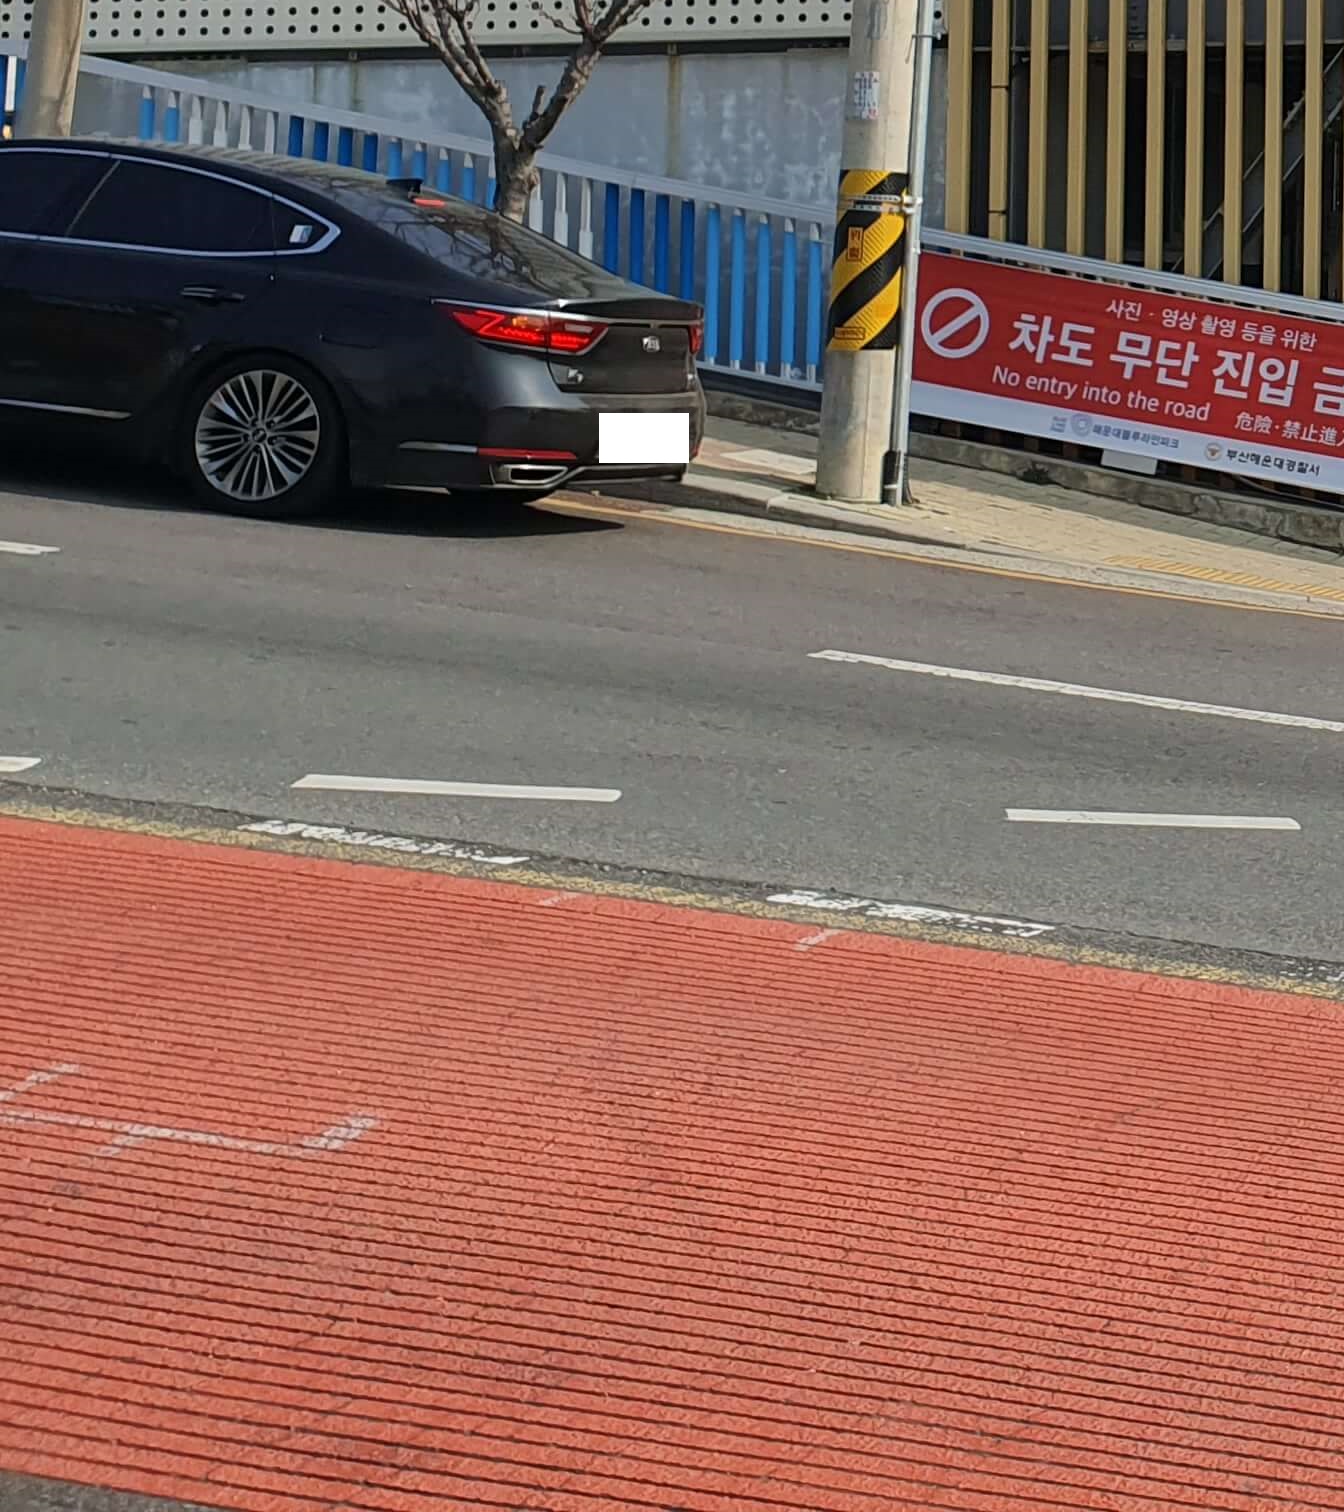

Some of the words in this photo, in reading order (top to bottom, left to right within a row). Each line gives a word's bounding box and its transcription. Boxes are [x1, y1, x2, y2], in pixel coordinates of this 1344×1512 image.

[1105, 299, 1143, 322] 사진
[1161, 308, 1198, 331] 영상
[1200, 315, 1237, 338] 촬영
[1241, 322, 1277, 346] 등을
[1280, 329, 1318, 353] 위한
[1008, 313, 1096, 367] 차도
[1109, 331, 1200, 389] 무단
[1212, 349, 1300, 408] 진입
[992, 365, 1021, 387] No
[1025, 375, 1078, 400] entry
[1082, 381, 1121, 405] into
[1127, 390, 1160, 413] the
[1164, 401, 1211, 422] road
